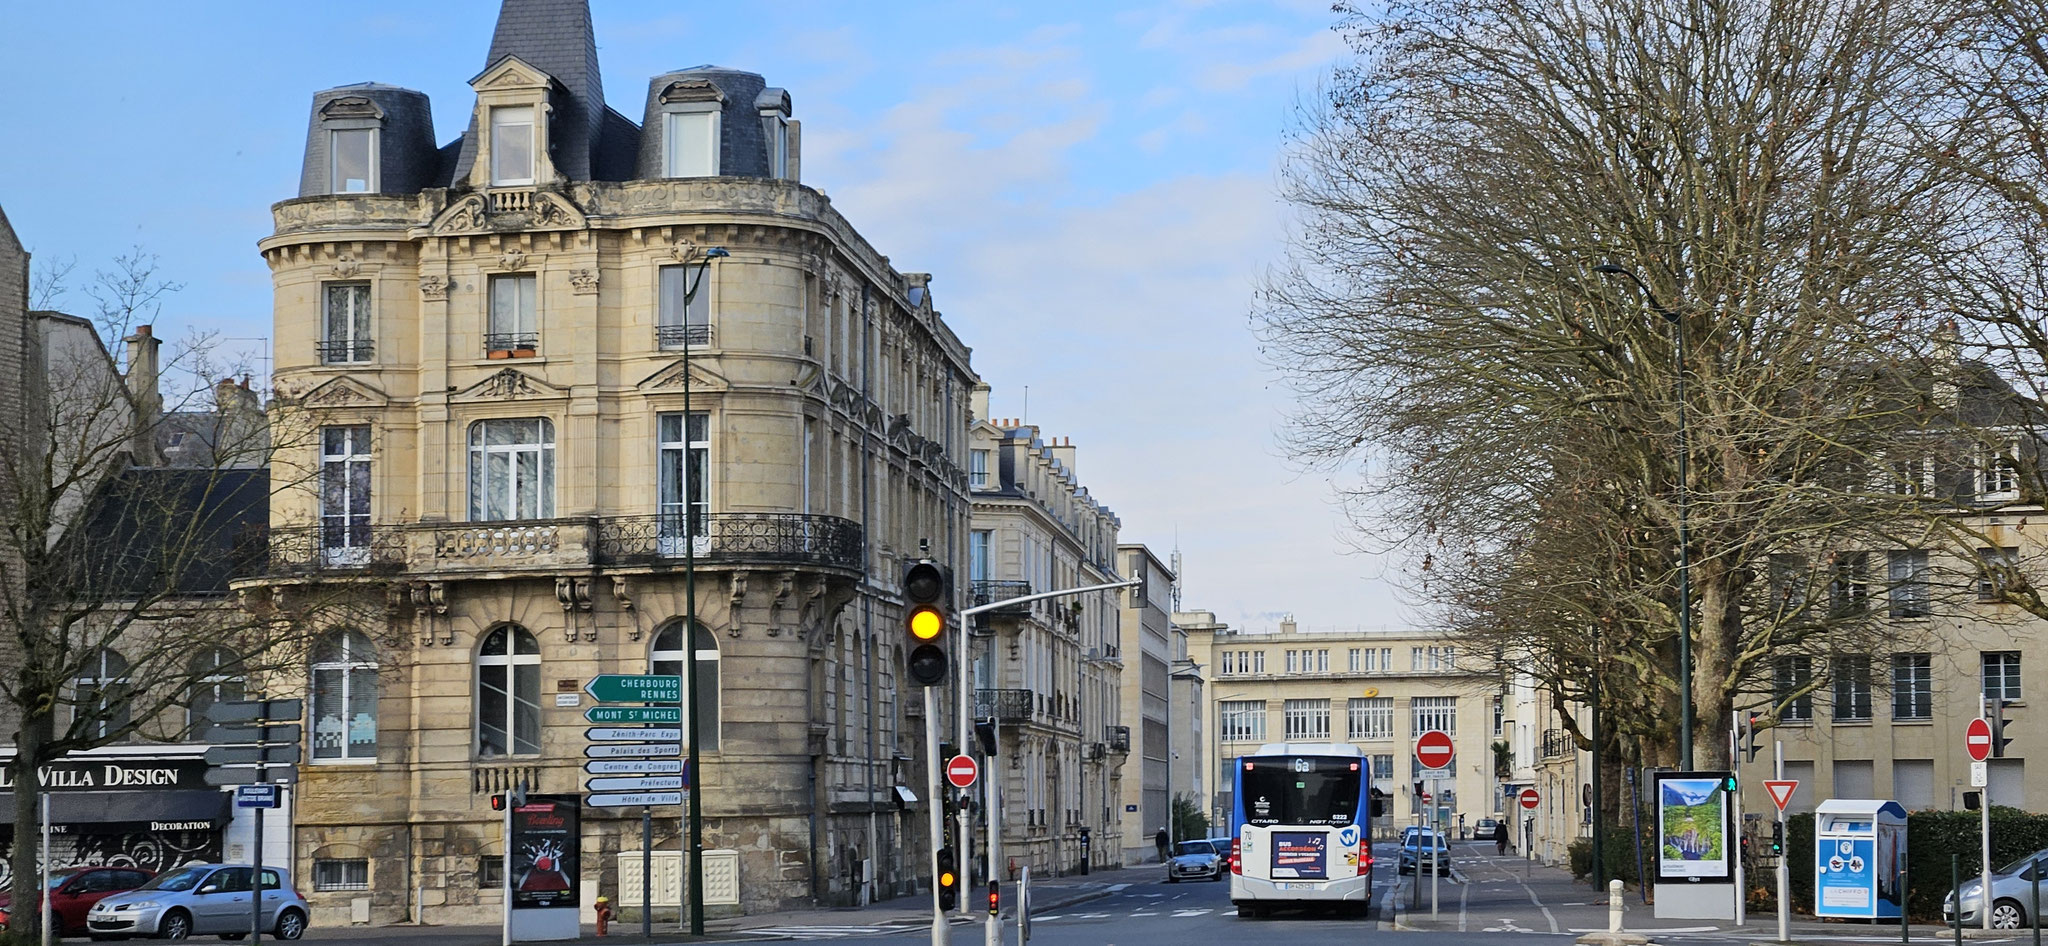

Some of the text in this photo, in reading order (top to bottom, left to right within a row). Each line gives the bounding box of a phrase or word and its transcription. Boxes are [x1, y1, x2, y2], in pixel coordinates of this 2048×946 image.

[620, 679, 678, 688] CHERBOURG
[641, 690, 678, 699] RENNES
[596, 711, 622, 720] MONT
[642, 711, 678, 720] MICHEL
[610, 746, 678, 755] Palais des Sports
[1295, 758, 1309, 772] 6a
[37, 765, 95, 787] VILLA
[103, 765, 179, 787] DESIGN
[622, 794, 679, 803] Hôtel de Ville
[151, 821, 211, 831] DECORATION
